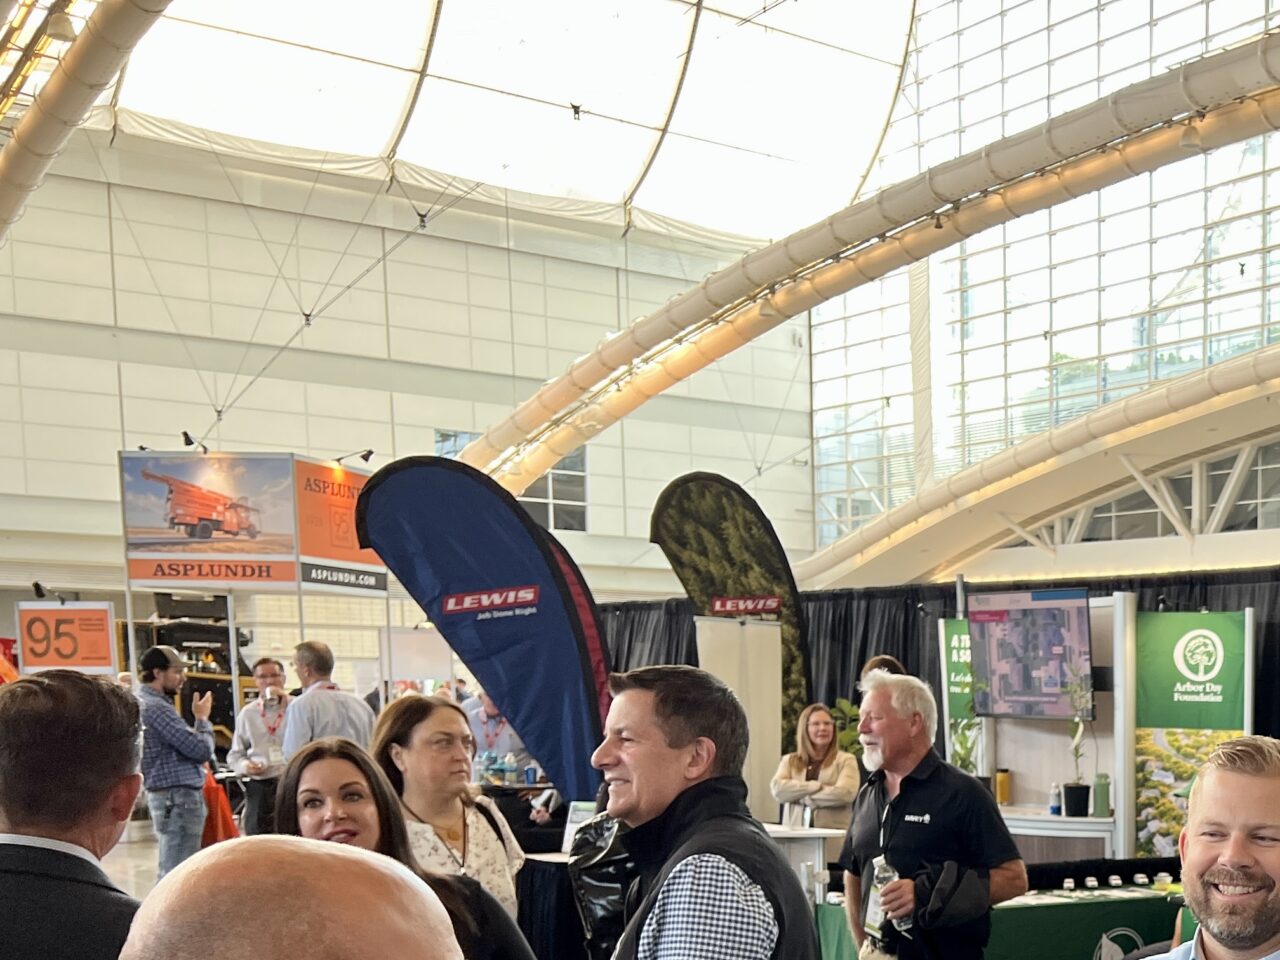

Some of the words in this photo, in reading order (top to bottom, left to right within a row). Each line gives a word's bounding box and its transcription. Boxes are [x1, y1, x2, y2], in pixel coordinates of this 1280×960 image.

[304, 477, 361, 499] ASPLUN
[153, 563, 272, 578] ASPLUNDH
[311, 568, 376, 586] ASPLUNDH.COM
[446, 588, 535, 611] LEWIS
[714, 598, 780, 611] LEWIS
[26, 616, 79, 660] 95
[1174, 682, 1205, 692] Arbor
[1206, 682, 1223, 694] Day
[1173, 693, 1223, 702] Foundation
